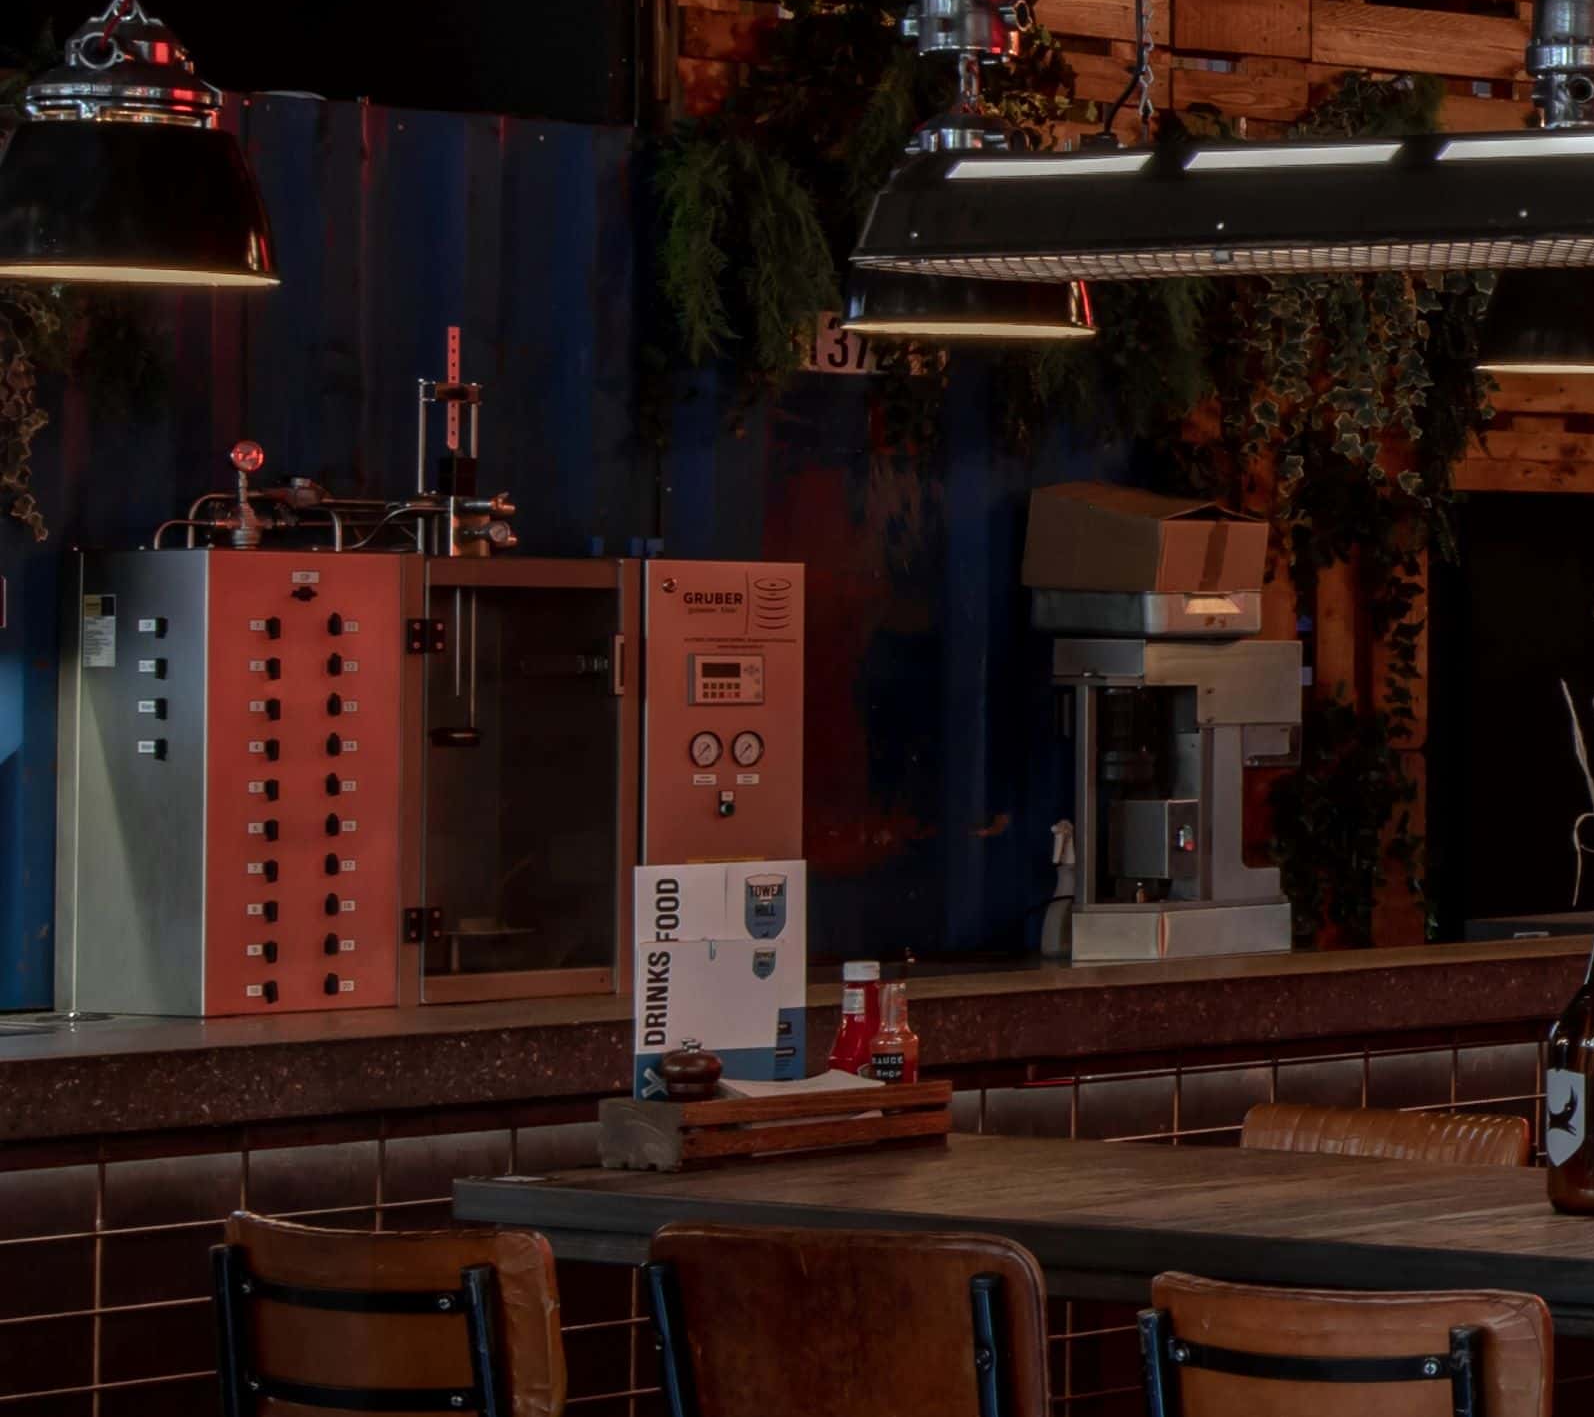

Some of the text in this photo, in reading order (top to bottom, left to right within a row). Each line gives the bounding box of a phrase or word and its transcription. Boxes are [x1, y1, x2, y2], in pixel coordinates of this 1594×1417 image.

[683, 591, 743, 604] GRUBER
[749, 884, 784, 897] TOWER
[655, 878, 680, 943] FOOD
[643, 950, 671, 1047] DRINKS
